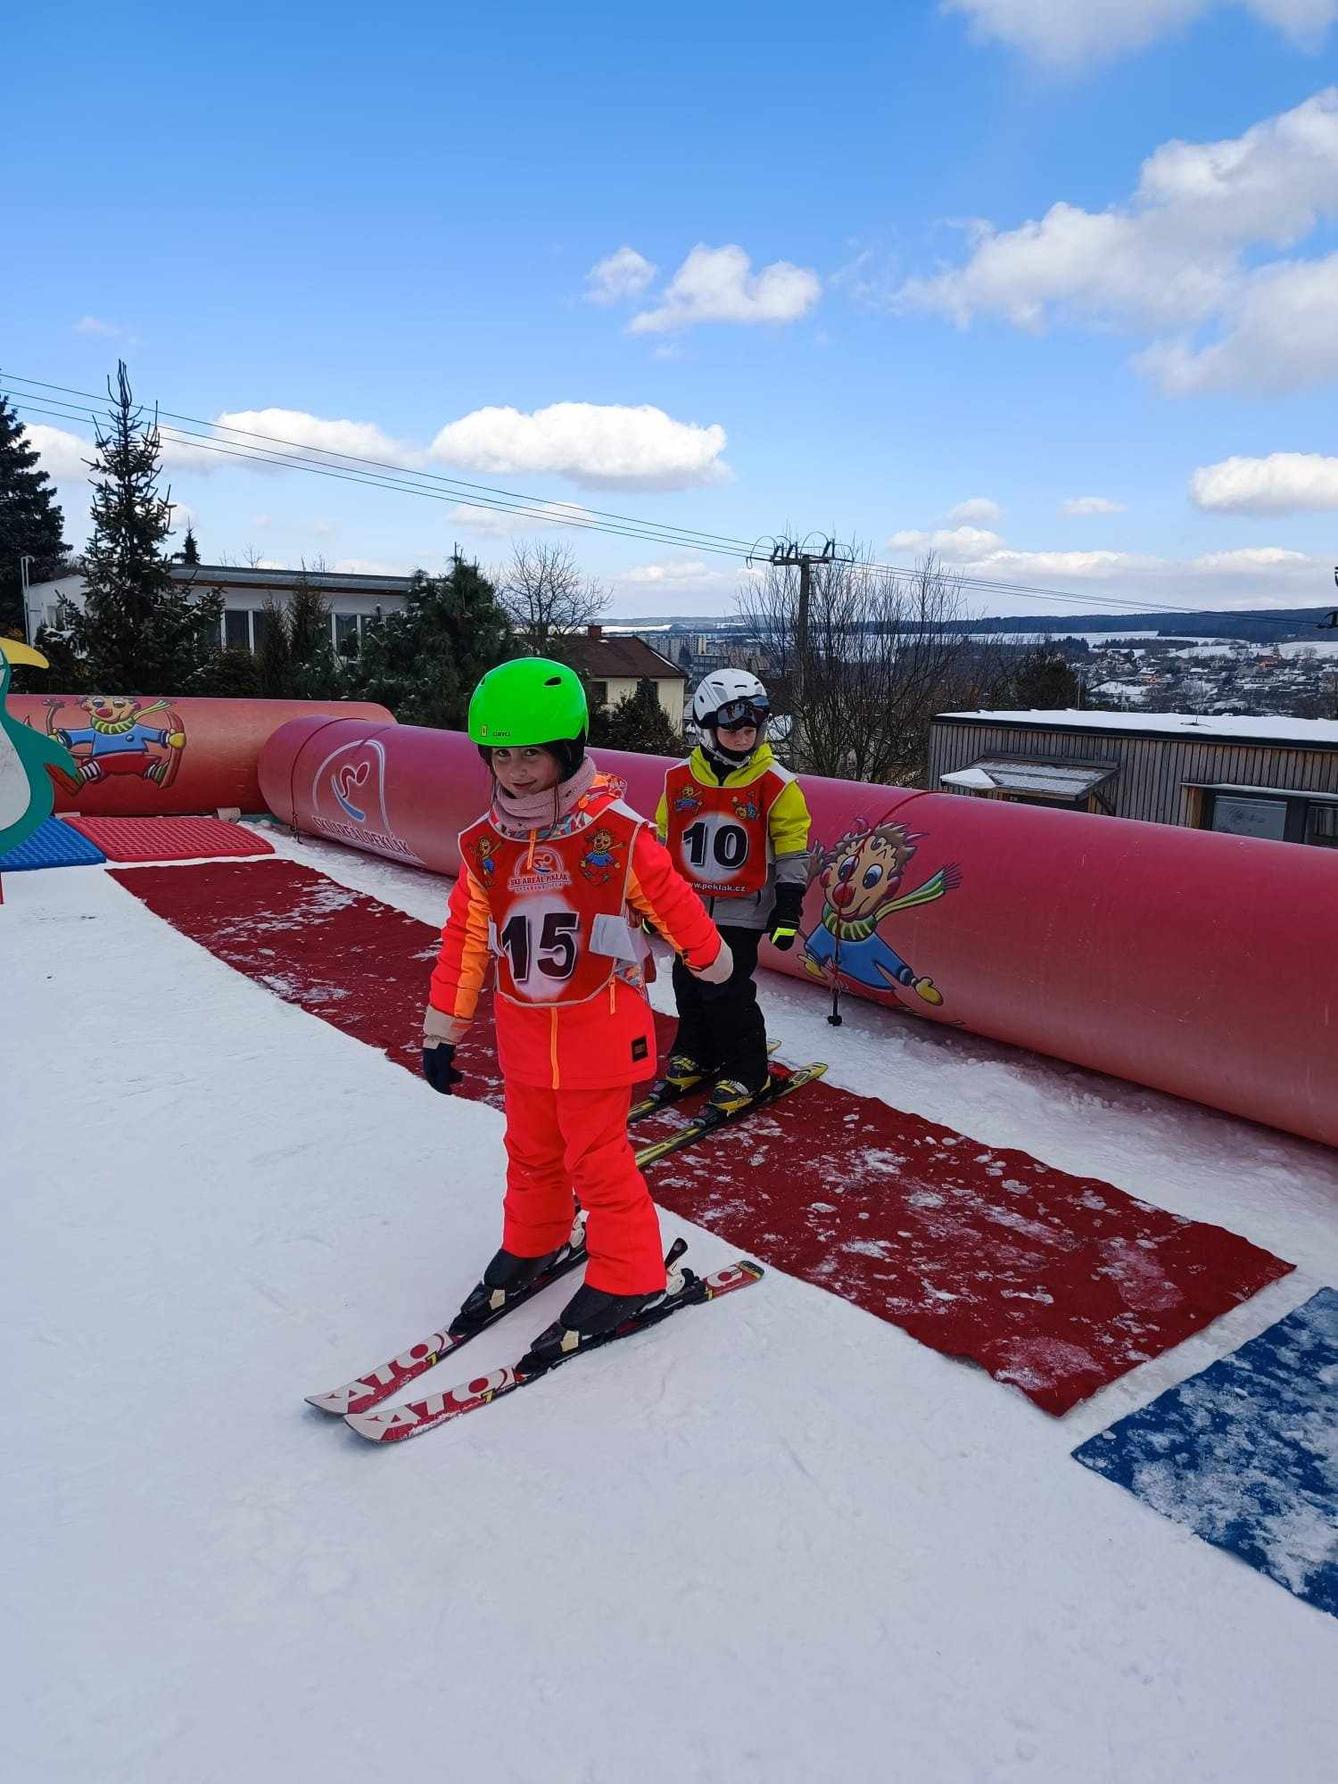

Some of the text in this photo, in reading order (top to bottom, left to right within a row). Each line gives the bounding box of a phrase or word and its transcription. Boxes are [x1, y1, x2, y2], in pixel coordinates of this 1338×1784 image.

[682, 821, 748, 869] 10
[688, 881, 746, 892] ww.peklak.cz
[501, 912, 580, 981] 15
[375, 1367, 514, 1440] ATO
